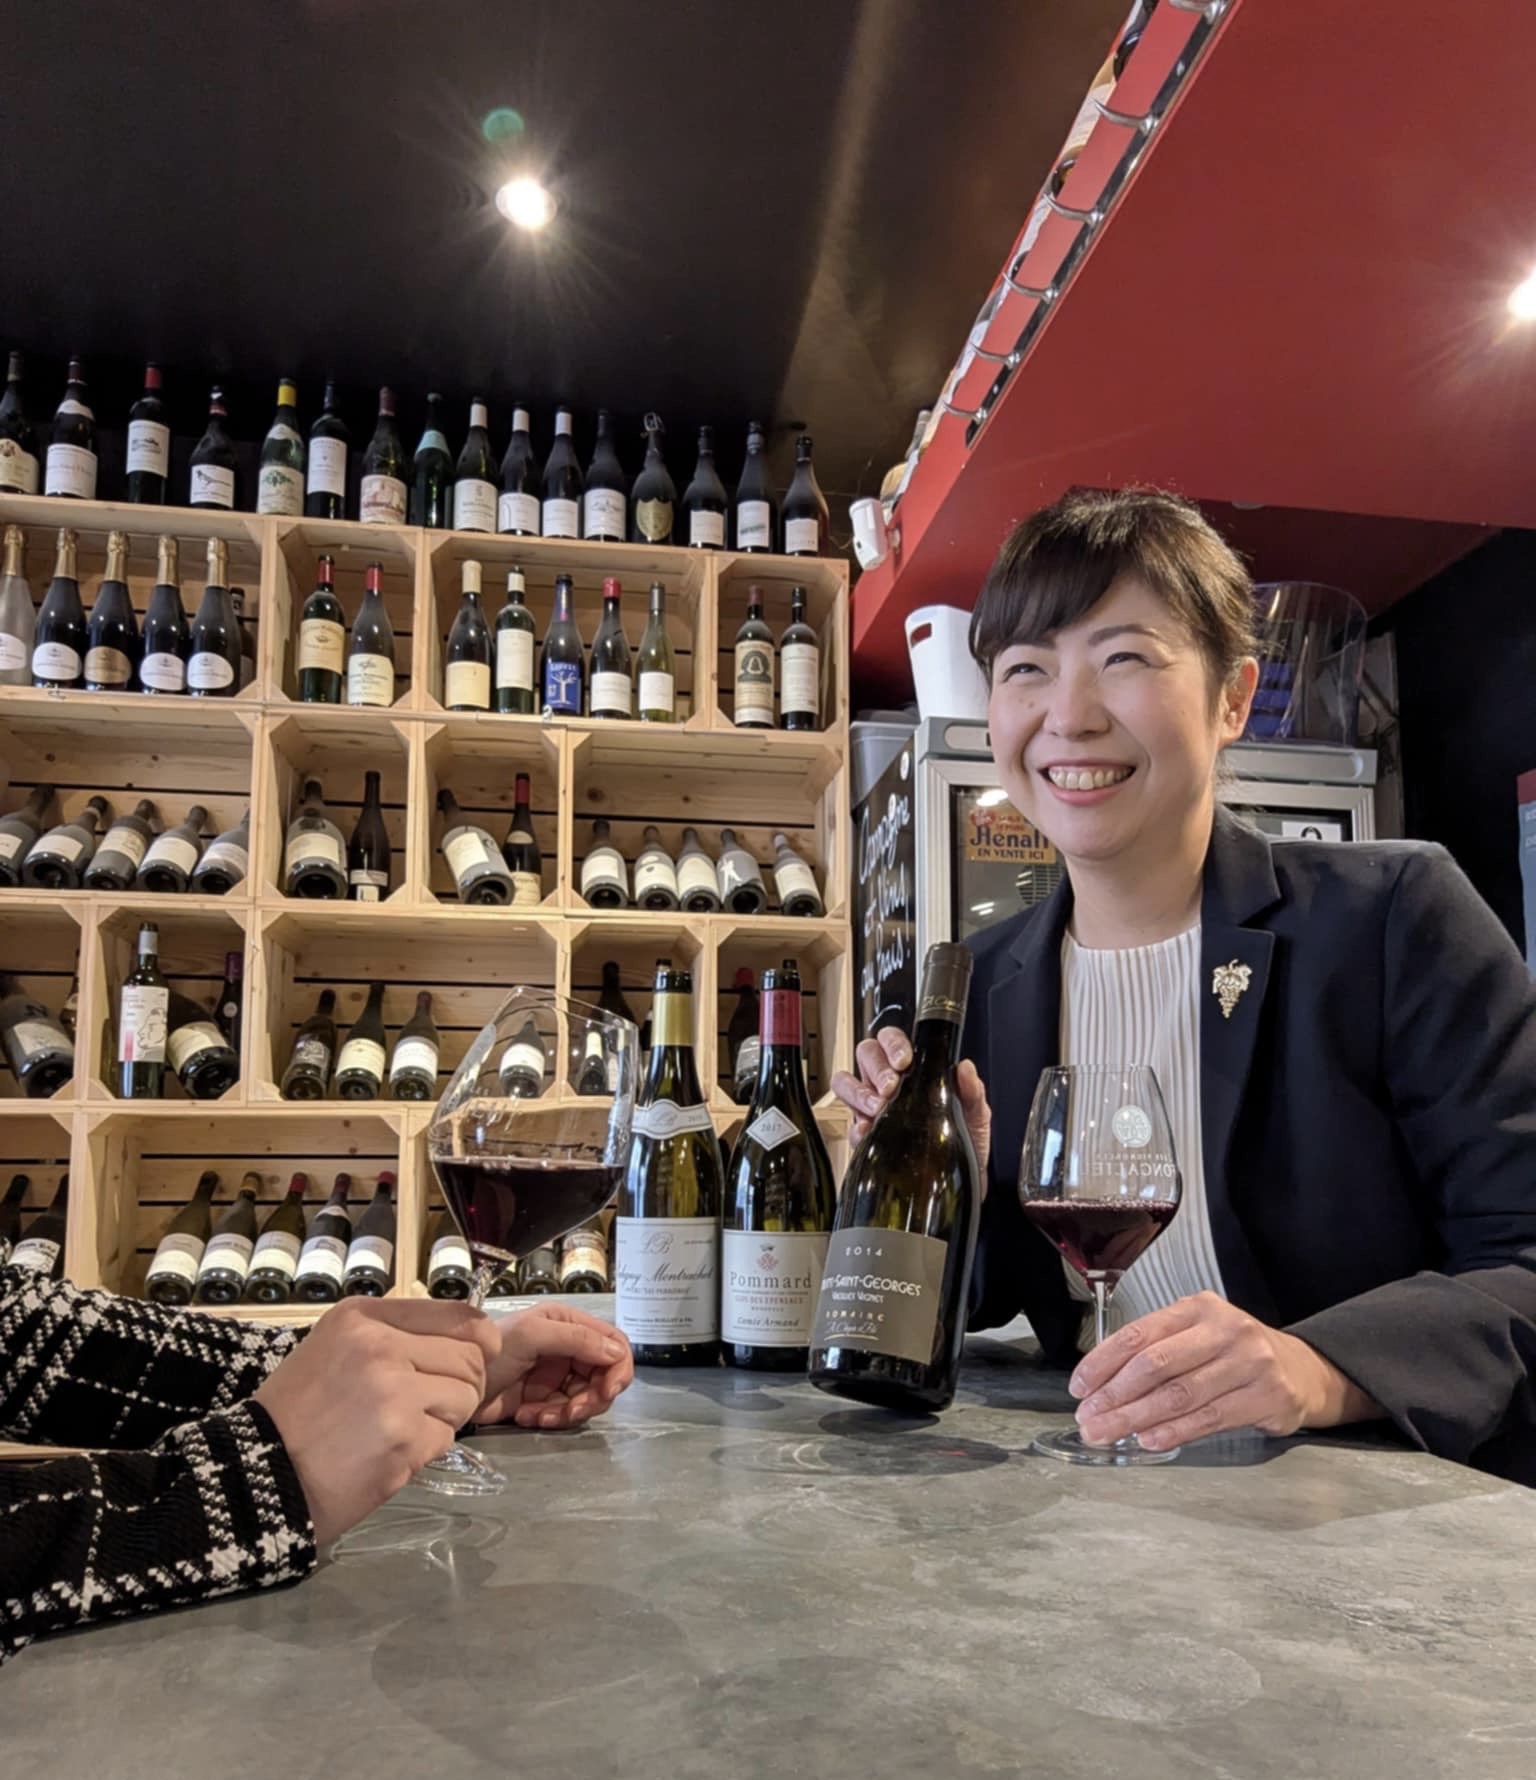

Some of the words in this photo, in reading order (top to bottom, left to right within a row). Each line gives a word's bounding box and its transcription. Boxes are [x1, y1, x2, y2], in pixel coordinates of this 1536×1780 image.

[978, 849, 991, 857] EN
[993, 849, 1025, 859] VENTE
[1029, 851, 1045, 860] ICI
[845, 1246, 883, 1257] 2014
[730, 1270, 812, 1289] Pommard
